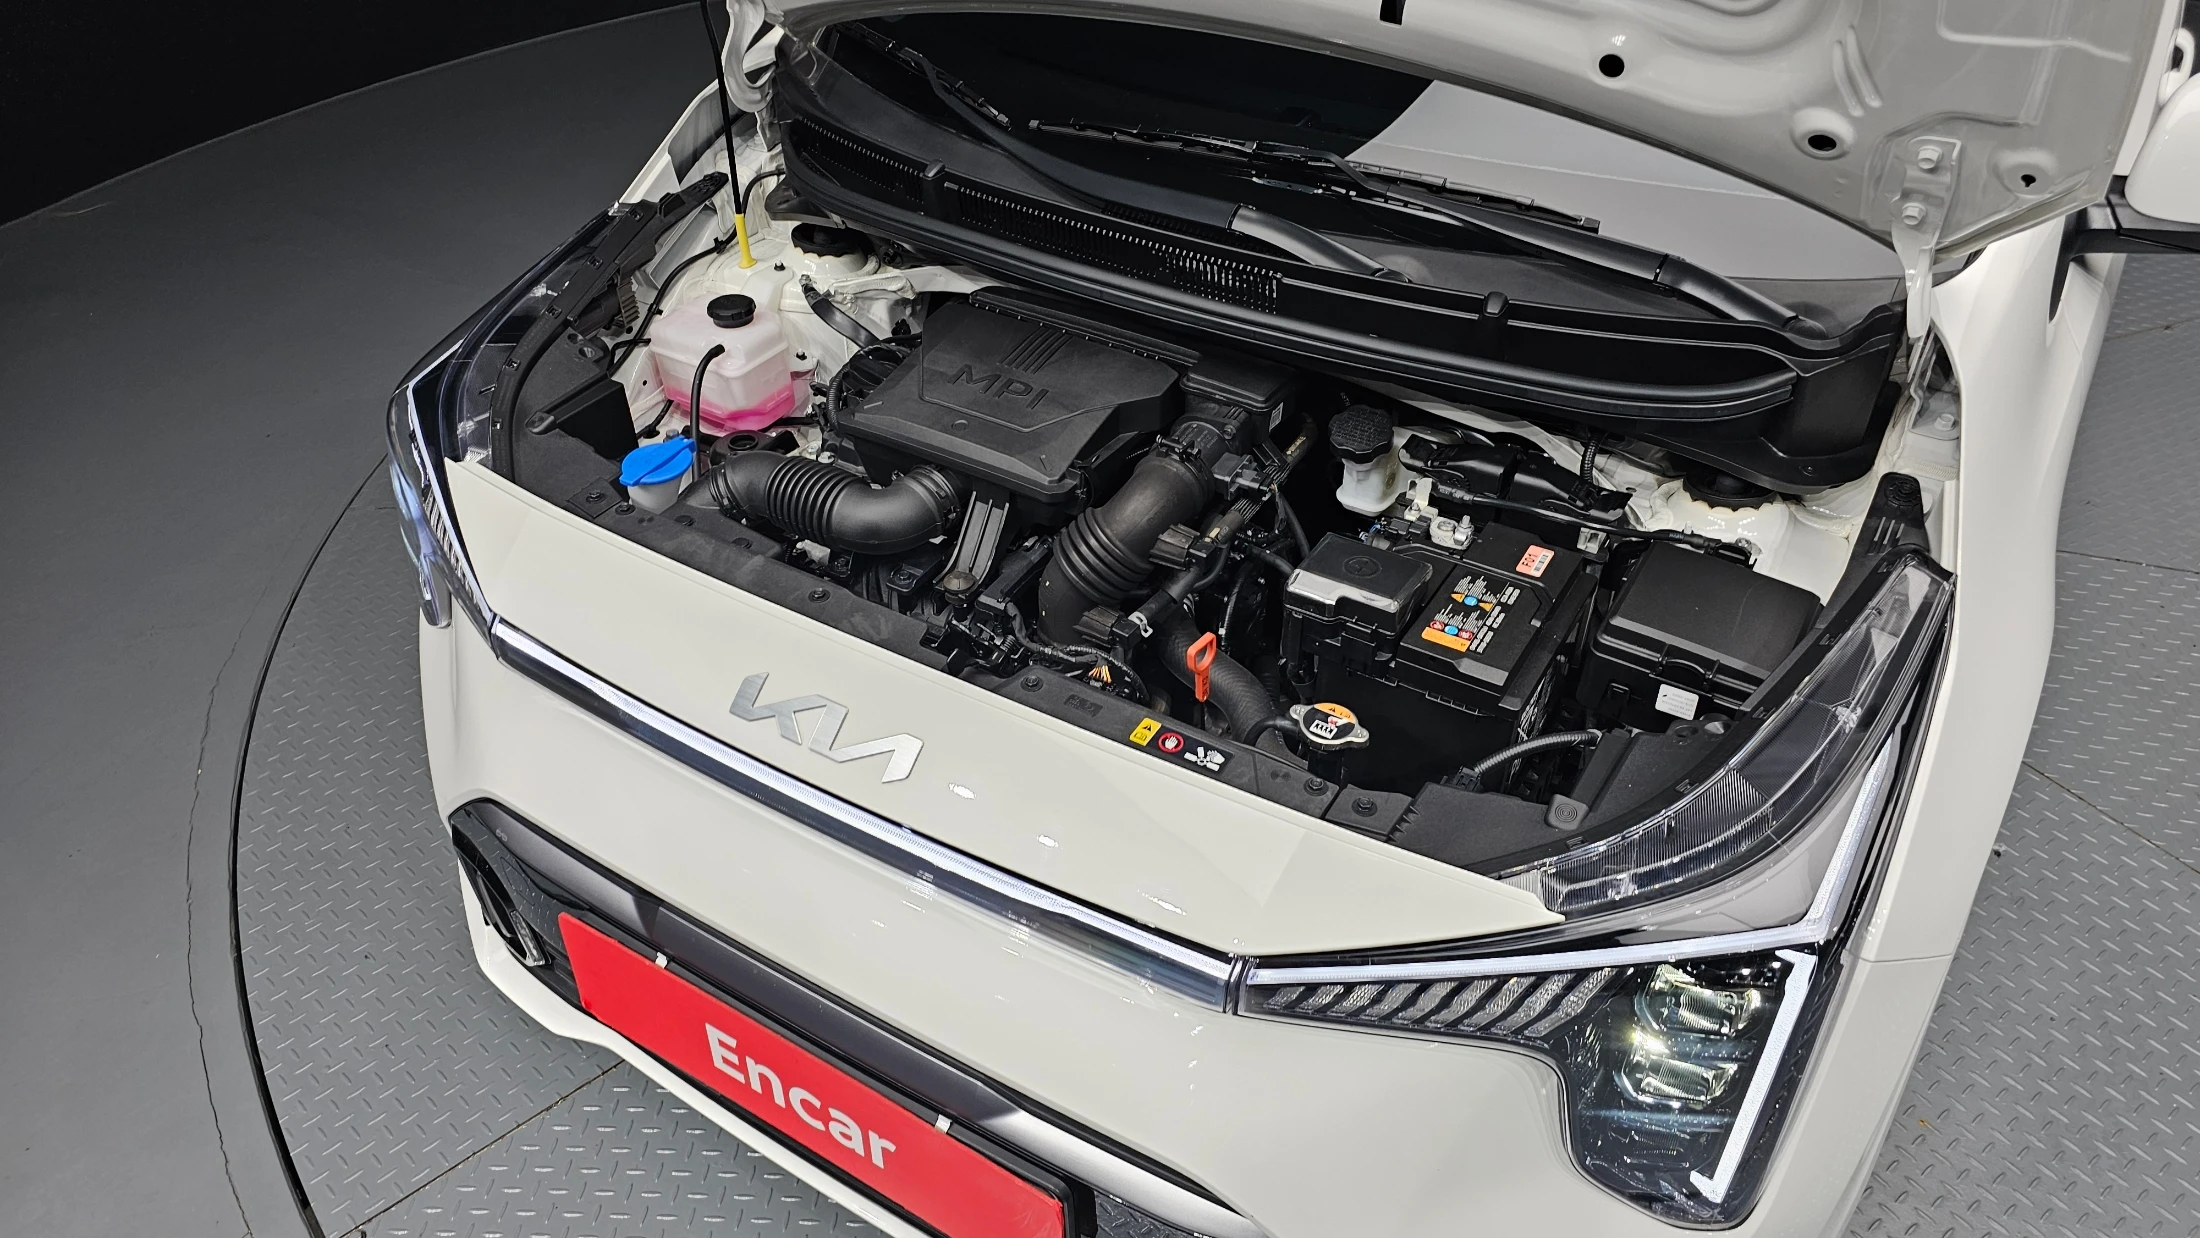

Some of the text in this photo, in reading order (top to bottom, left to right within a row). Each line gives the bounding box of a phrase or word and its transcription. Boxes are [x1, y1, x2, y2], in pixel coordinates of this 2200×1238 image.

[947, 363, 1050, 410] MPI
[728, 671, 924, 783] KIA
[703, 1022, 896, 1170] Encar
